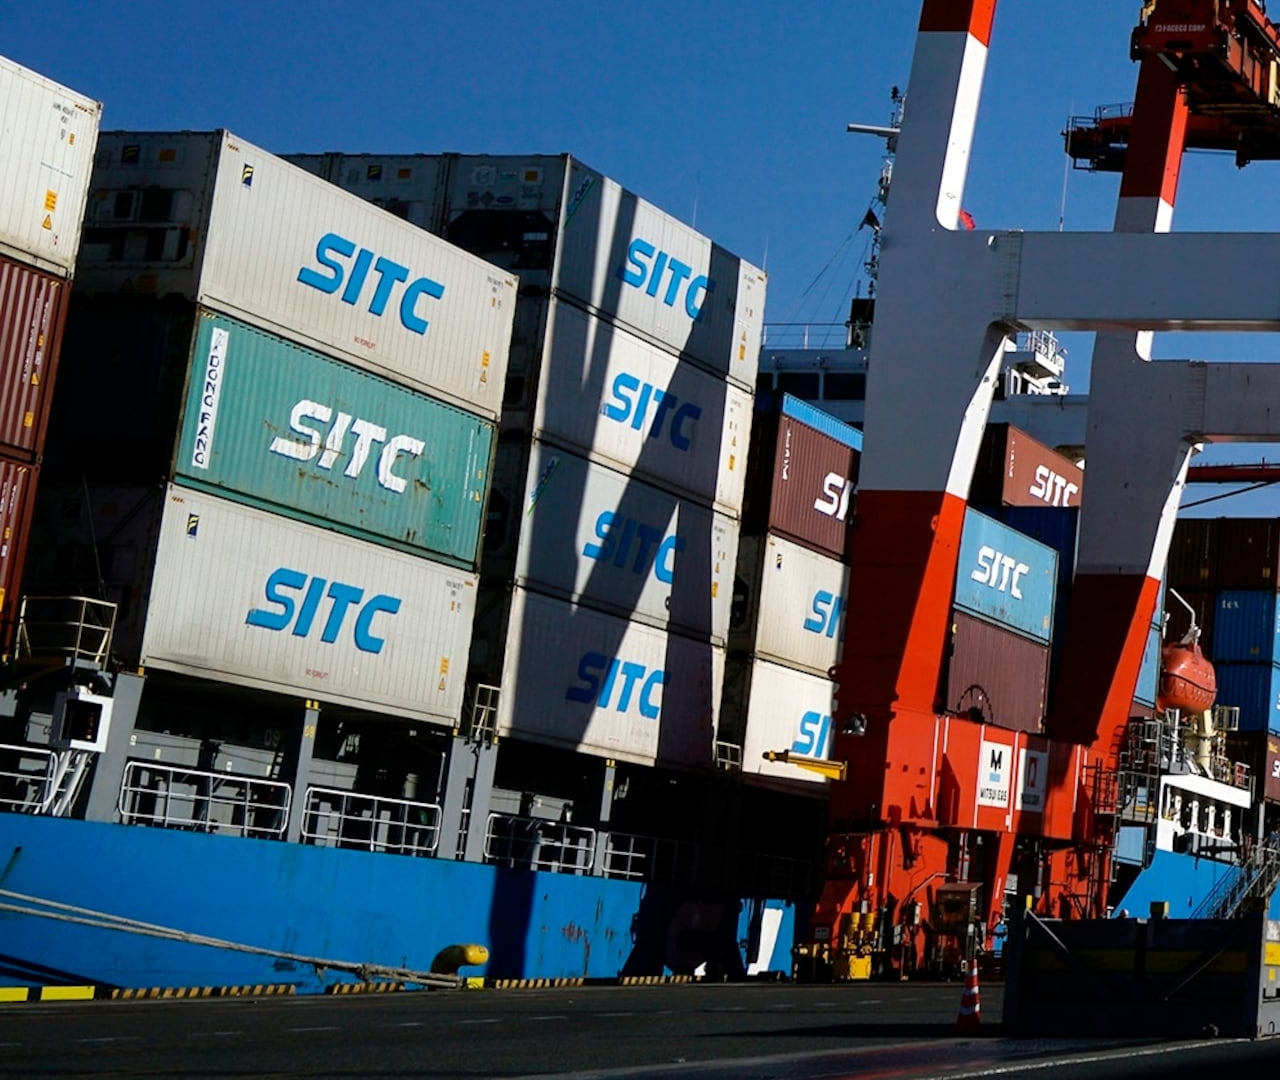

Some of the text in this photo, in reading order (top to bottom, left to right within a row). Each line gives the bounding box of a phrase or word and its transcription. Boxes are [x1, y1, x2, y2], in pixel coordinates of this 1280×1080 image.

[297, 232, 445, 335] SITC
[615, 237, 717, 323] SITC
[194, 355, 220, 465] DONG FANG
[269, 399, 426, 494] SITC
[604, 372, 702, 452] SITC
[1029, 464, 1079, 507] SITC
[582, 510, 686, 585] SITC
[971, 545, 1030, 600] SITC
[245, 567, 402, 655] SITC
[565, 651, 671, 720] SITC
